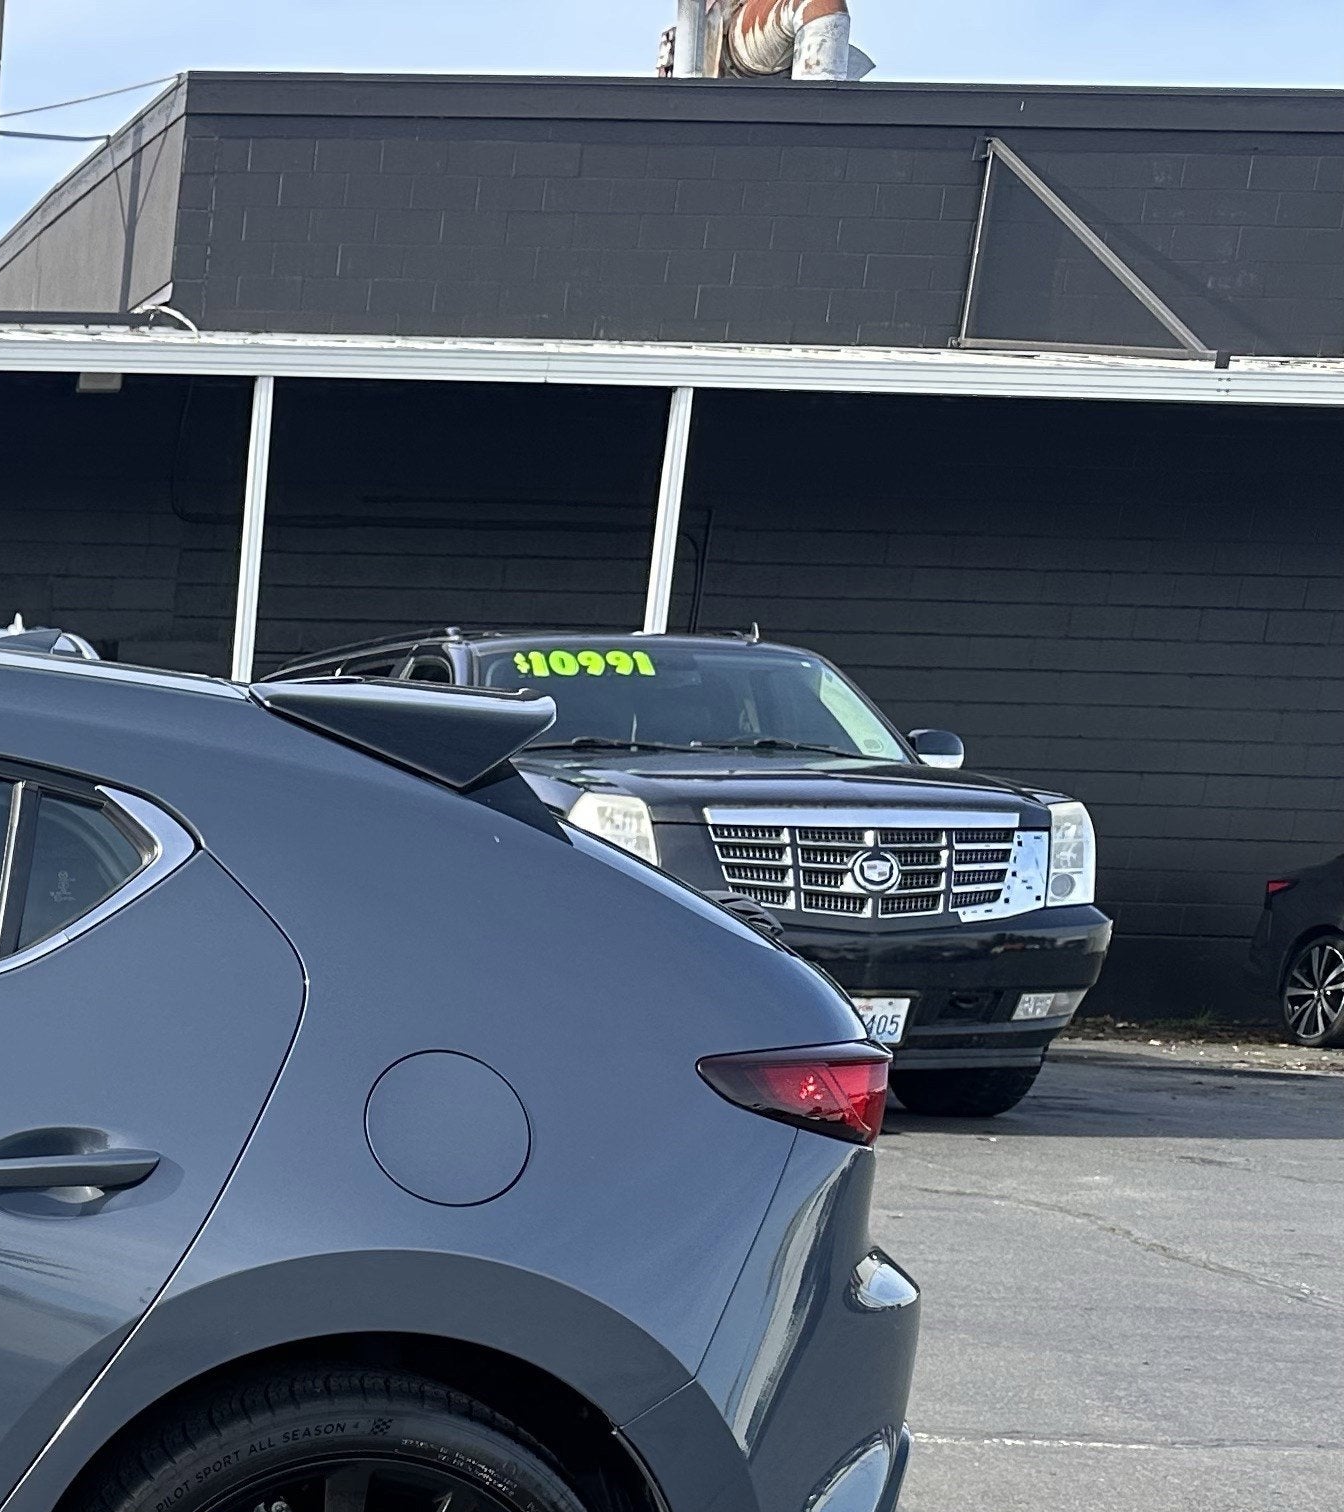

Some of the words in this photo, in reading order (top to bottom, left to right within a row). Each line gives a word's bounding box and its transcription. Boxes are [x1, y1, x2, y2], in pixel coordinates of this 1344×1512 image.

[513, 650, 656, 677] $10991
[194, 1450, 240, 1483] SPORT
[247, 1438, 276, 1456] ALL
[282, 1422, 347, 1443] SEASON
